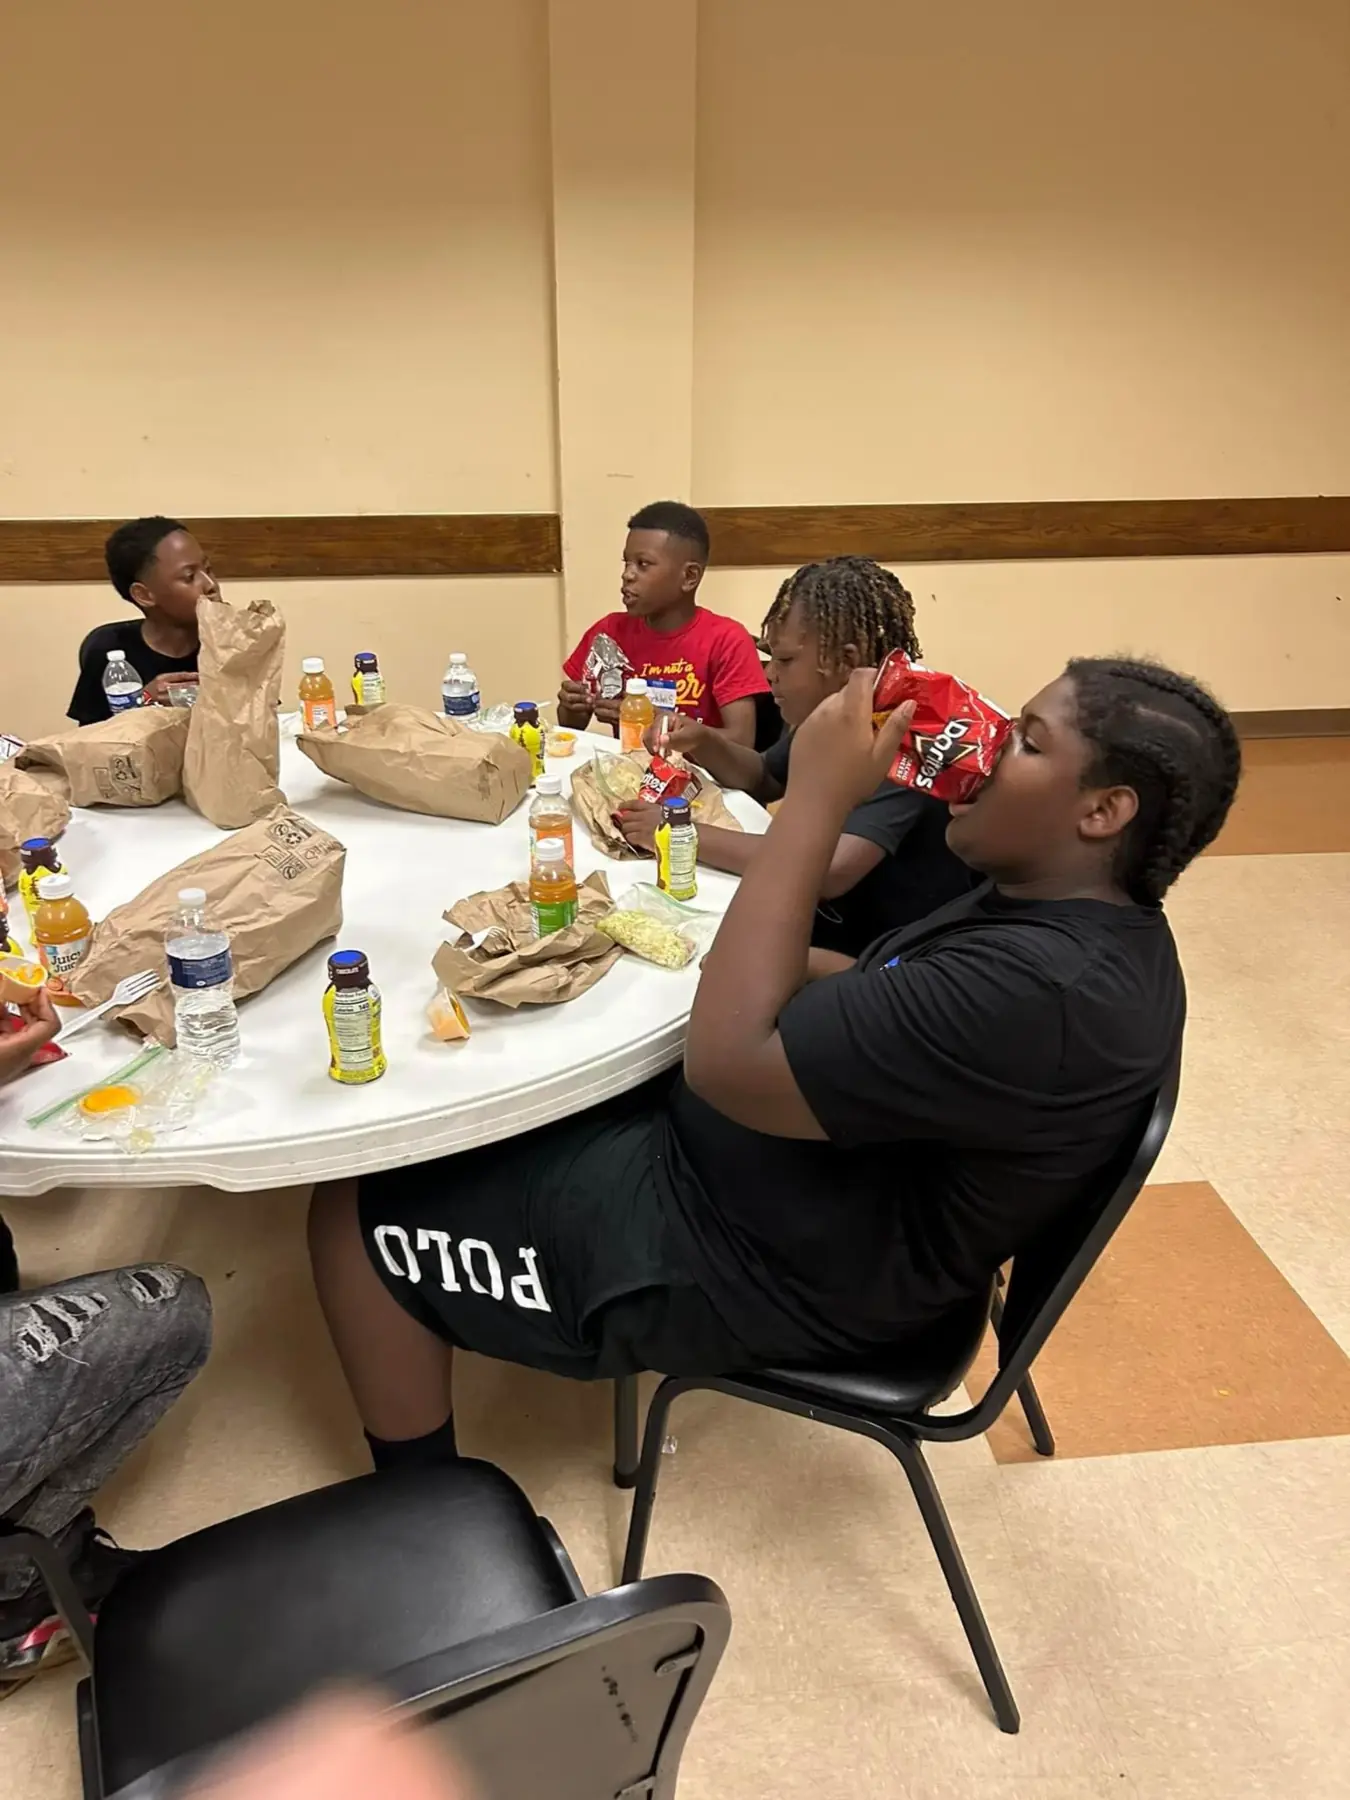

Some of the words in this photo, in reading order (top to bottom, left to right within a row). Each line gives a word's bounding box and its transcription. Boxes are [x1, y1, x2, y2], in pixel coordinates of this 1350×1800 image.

[640, 663, 662, 677] I'm
[663, 658, 687, 674] not
[685, 663, 694, 673] a
[915, 721, 968, 788] Doritos
[54, 962, 76, 973] Juic
[373, 1224, 552, 1313] POLO
